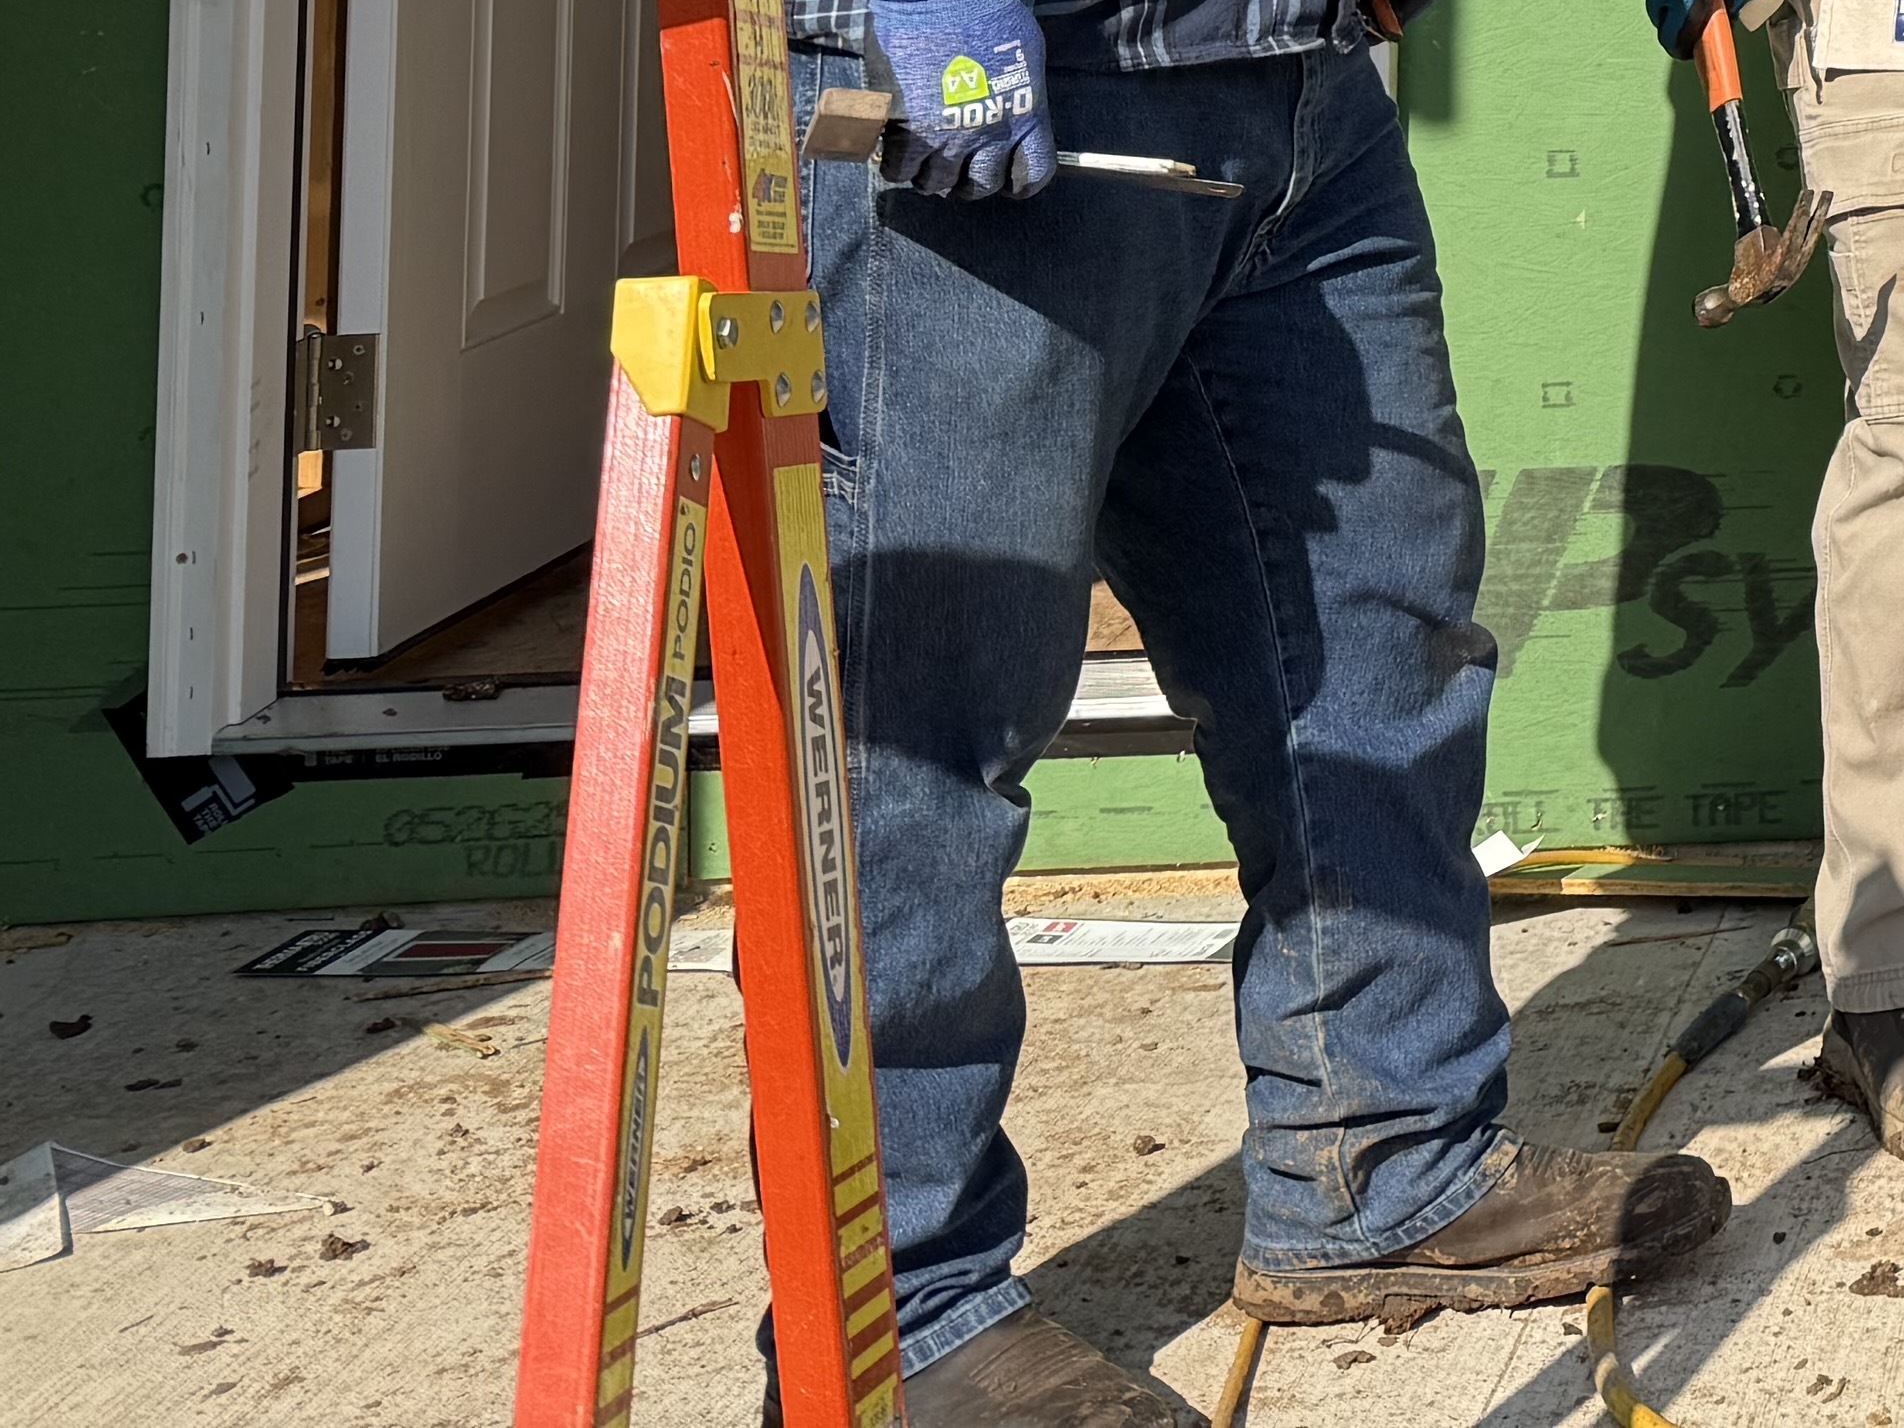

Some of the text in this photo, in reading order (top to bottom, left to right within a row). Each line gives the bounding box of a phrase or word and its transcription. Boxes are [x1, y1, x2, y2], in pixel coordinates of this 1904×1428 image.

[946, 67, 979, 93] A4
[634, 673, 692, 1008] PODIUM
[806, 668, 843, 976] WERNER
